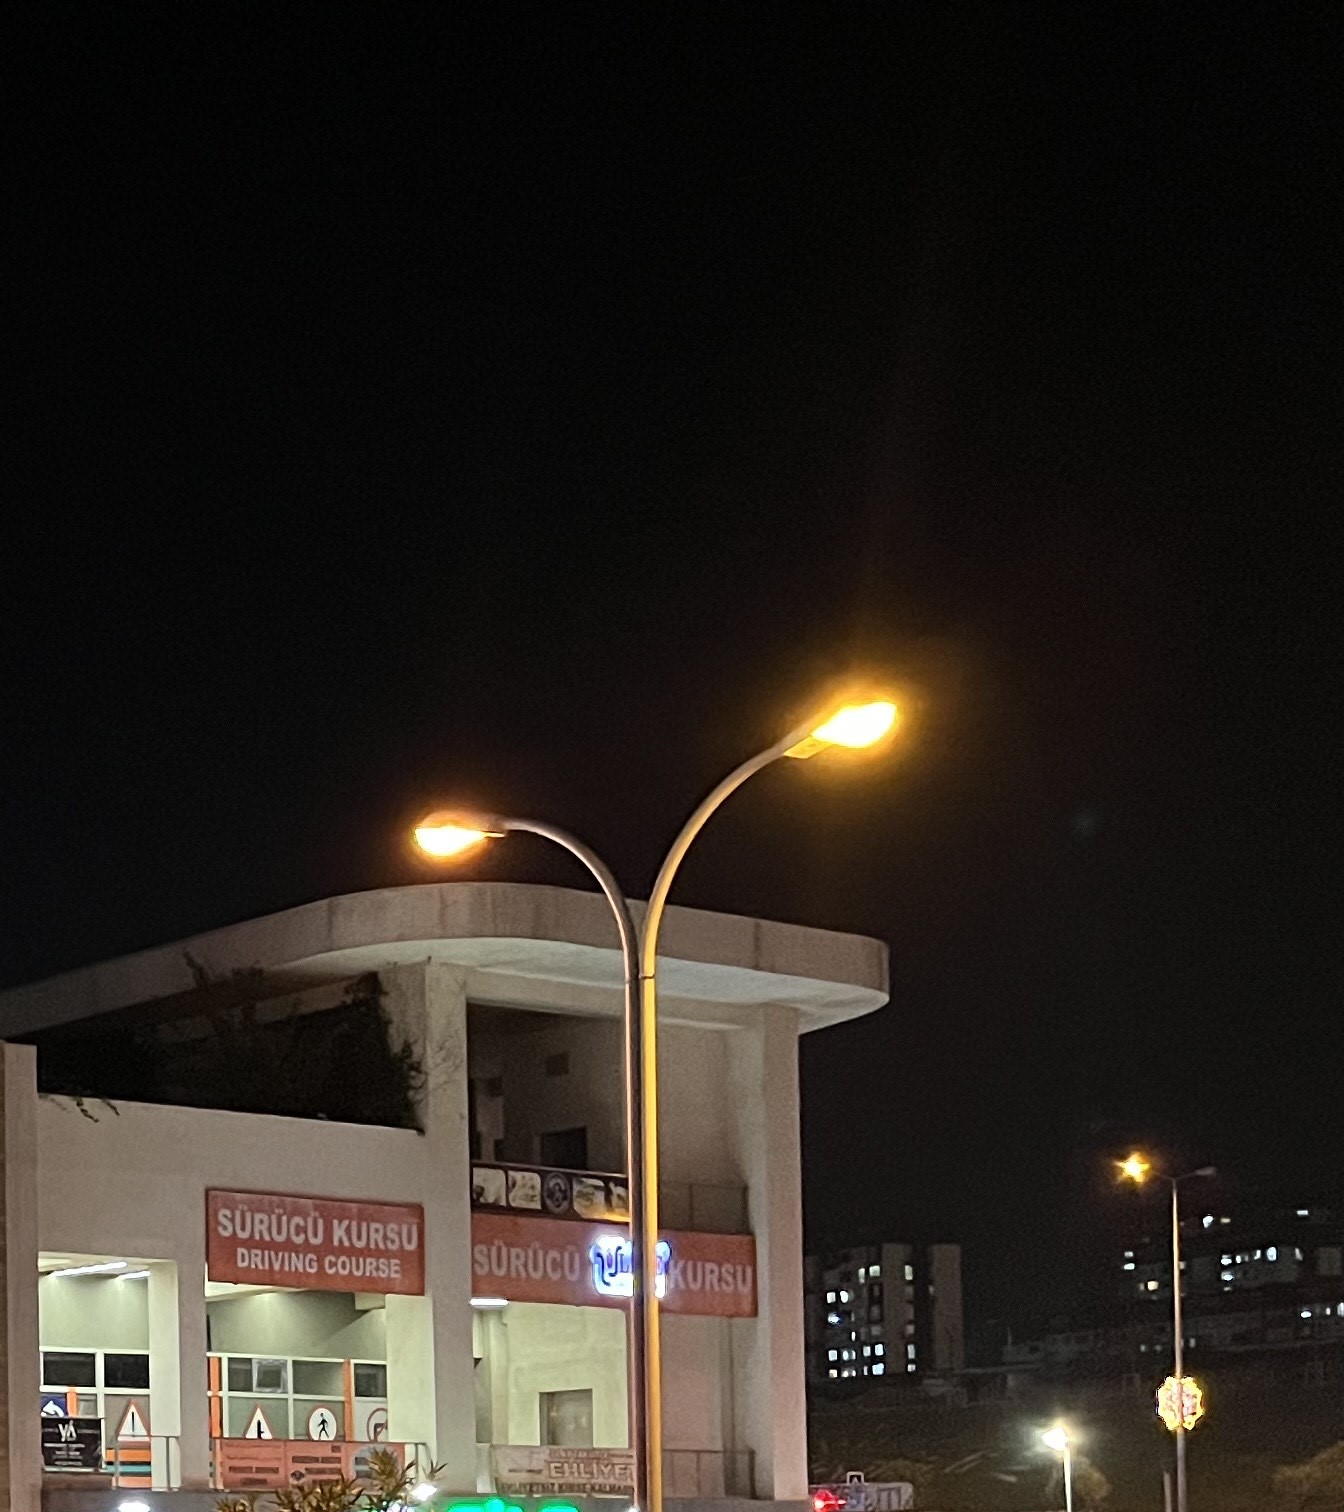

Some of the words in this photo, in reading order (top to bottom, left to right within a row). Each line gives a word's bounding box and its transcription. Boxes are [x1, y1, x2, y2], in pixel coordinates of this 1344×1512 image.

[216, 1204, 325, 1248] SÜRÜCÜ
[331, 1217, 419, 1252] KURSU
[236, 1245, 318, 1273] DRIVING
[324, 1254, 402, 1282] COURSE
[473, 1239, 581, 1283] SÜRÜCÜ
[670, 1259, 753, 1294] KURSU
